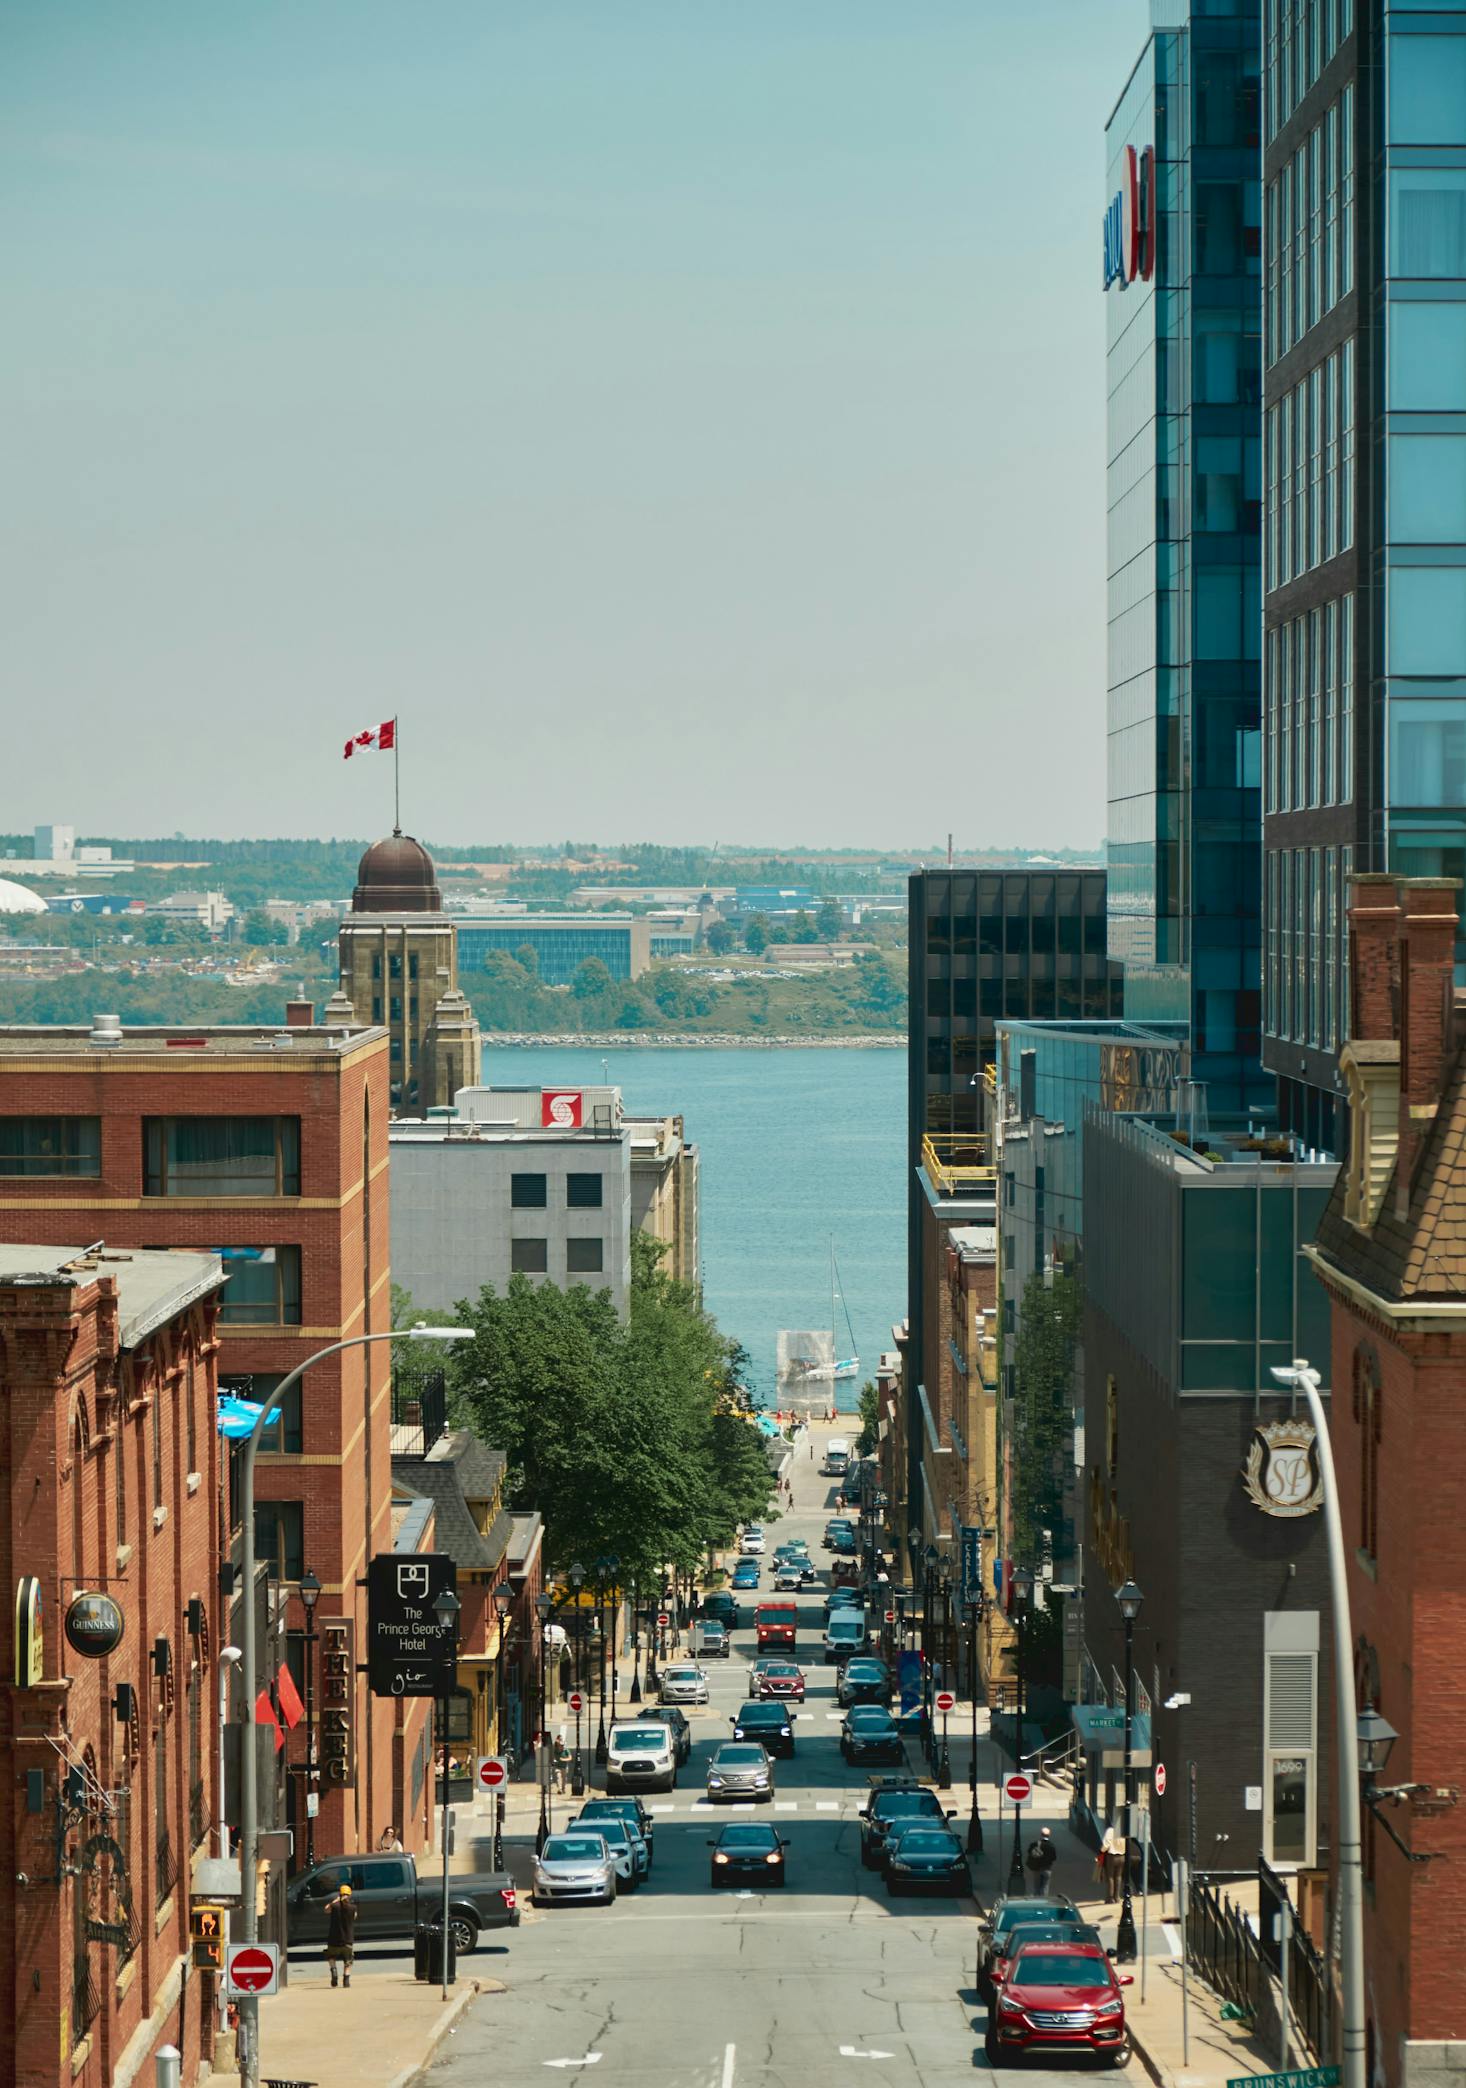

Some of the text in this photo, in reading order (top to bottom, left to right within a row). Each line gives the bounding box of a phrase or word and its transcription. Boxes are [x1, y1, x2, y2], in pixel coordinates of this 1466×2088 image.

[403, 1606, 423, 1619] The
[72, 1619, 115, 1630] GUINNESS
[378, 1623, 409, 1635] Prince
[400, 1639, 426, 1650] Hotel
[391, 1669, 427, 1694] gio
